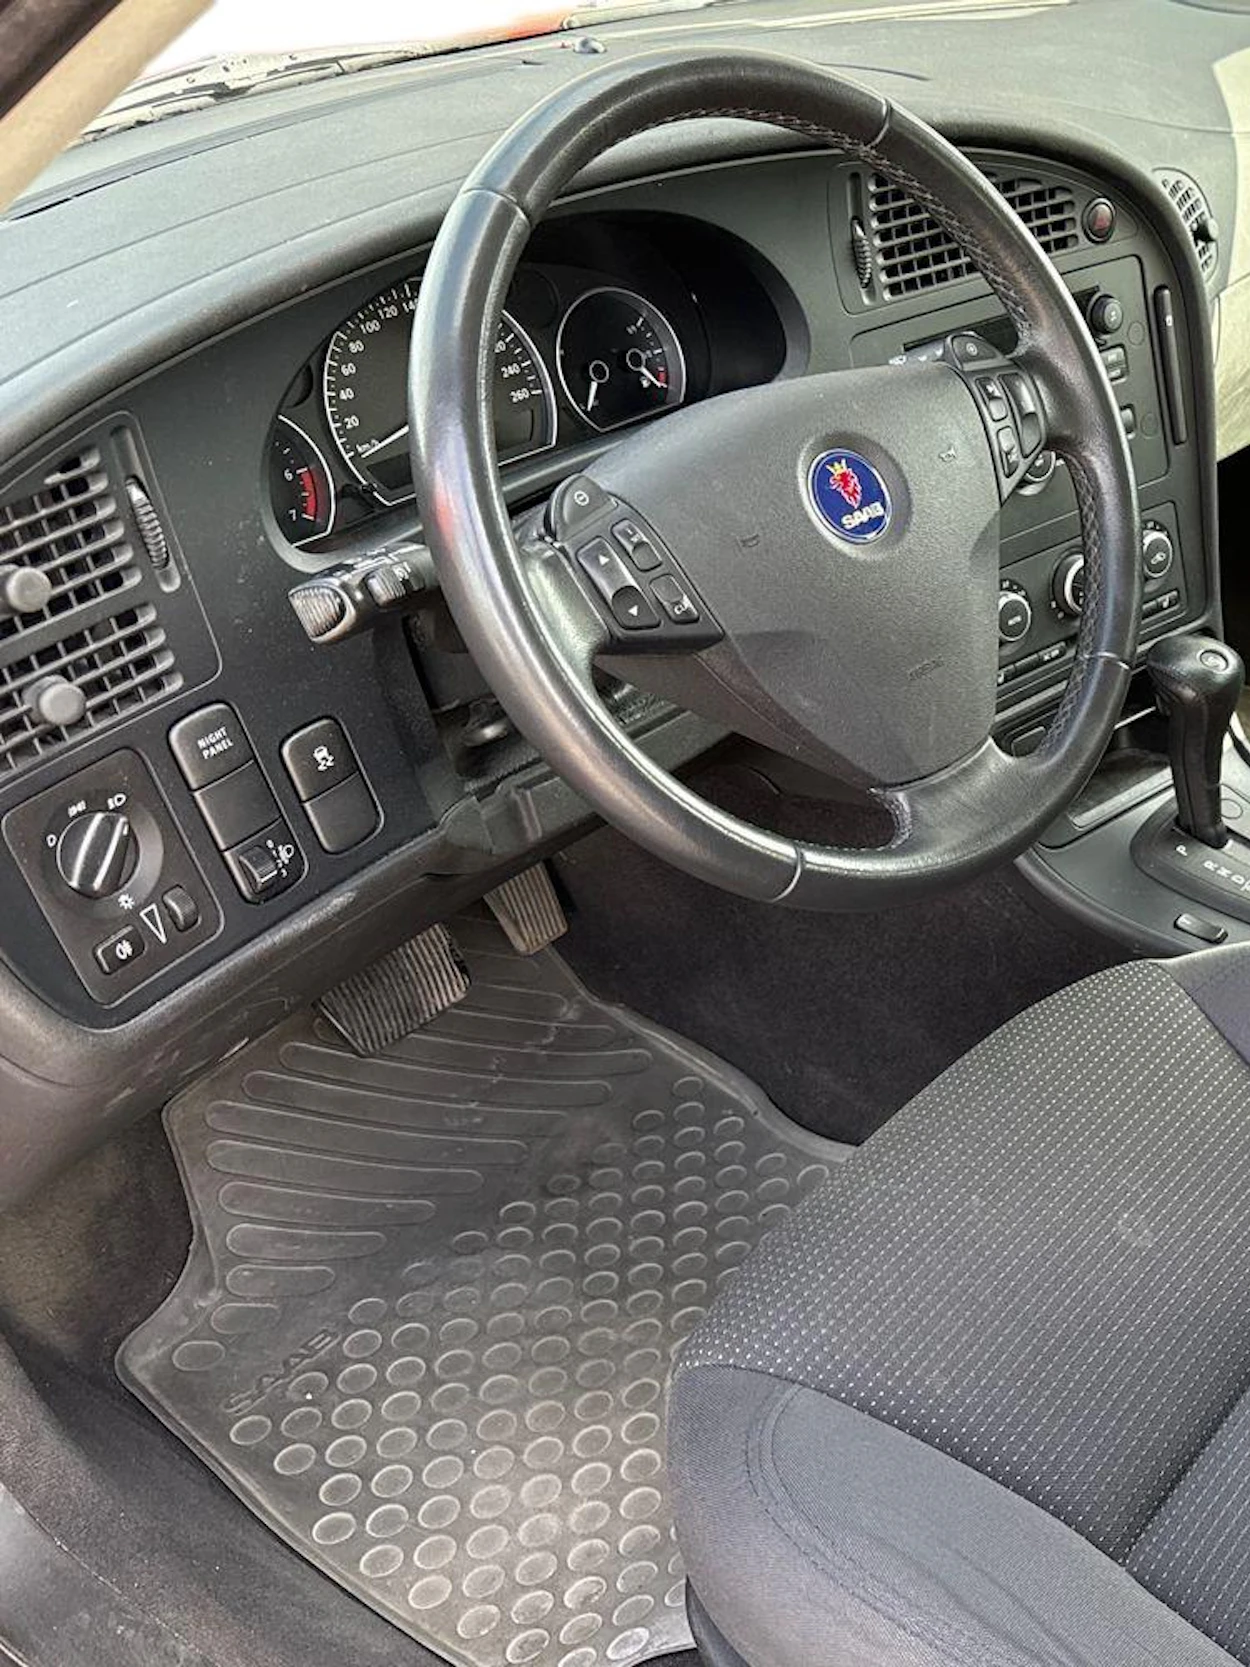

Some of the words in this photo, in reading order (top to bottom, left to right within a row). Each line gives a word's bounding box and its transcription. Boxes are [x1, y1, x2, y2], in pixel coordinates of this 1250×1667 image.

[378, 304, 399, 320] 120
[360, 319, 381, 335] 100
[348, 339, 365, 353] 80
[340, 362, 357, 376] 60
[501, 362, 521, 379] 240
[339, 387, 355, 401] 40
[510, 387, 530, 404] 260
[344, 415, 360, 430] 20
[283, 467, 294, 482] 6
[288, 509, 297, 521] 7
[841, 501, 885, 530] SAAB
[197, 726, 227, 750] NIGHT
[202, 737, 234, 760] PANEL
